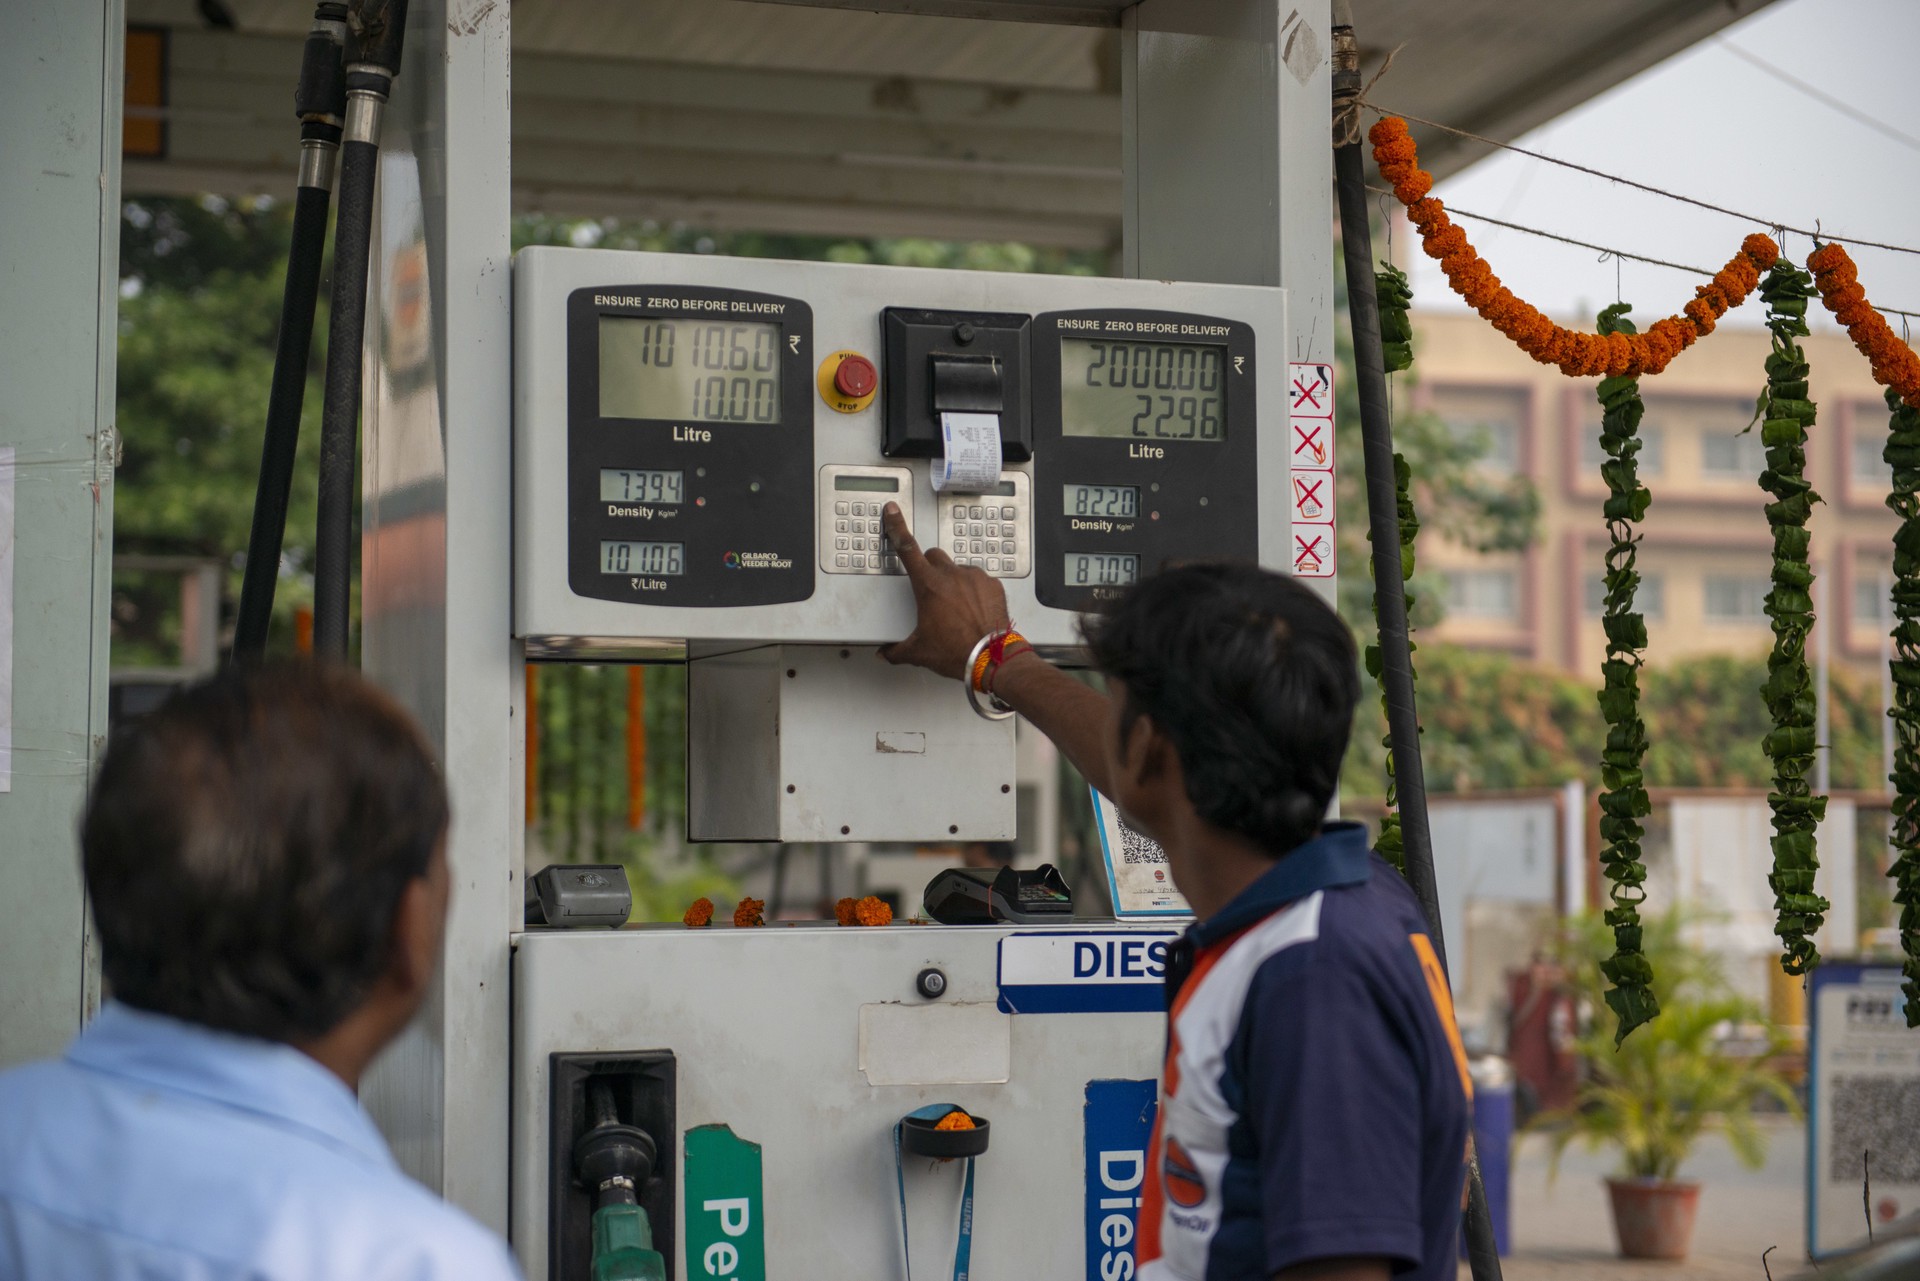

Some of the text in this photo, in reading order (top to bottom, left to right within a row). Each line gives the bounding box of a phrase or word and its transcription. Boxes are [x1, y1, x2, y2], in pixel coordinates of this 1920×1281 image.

[594, 295, 786, 314] ENSURE ZERO BEFORE DELIVERY
[1057, 318, 1231, 336] ENSURE ZERO BEFORE DELIVERY
[1087, 344, 1219, 392] 2000.00
[692, 376, 776, 422] 10.00
[837, 402, 858, 410] STOP
[1132, 394, 1218, 439] 22.96
[672, 426, 712, 442] Litre
[1129, 444, 1164, 458] Litre
[619, 472, 681, 502] 739.4
[608, 505, 654, 520] Density
[1076, 487, 1134, 516] 822.0
[1071, 519, 1113, 533] Density
[606, 544, 680, 573] 101.06
[741, 552, 778, 560] GILBARCO
[741, 560, 793, 568] VEEDER-ROOT
[1074, 941, 1168, 977] DIES
[1100, 1150, 1144, 1281] Dies
[704, 1197, 749, 1281] Pe
